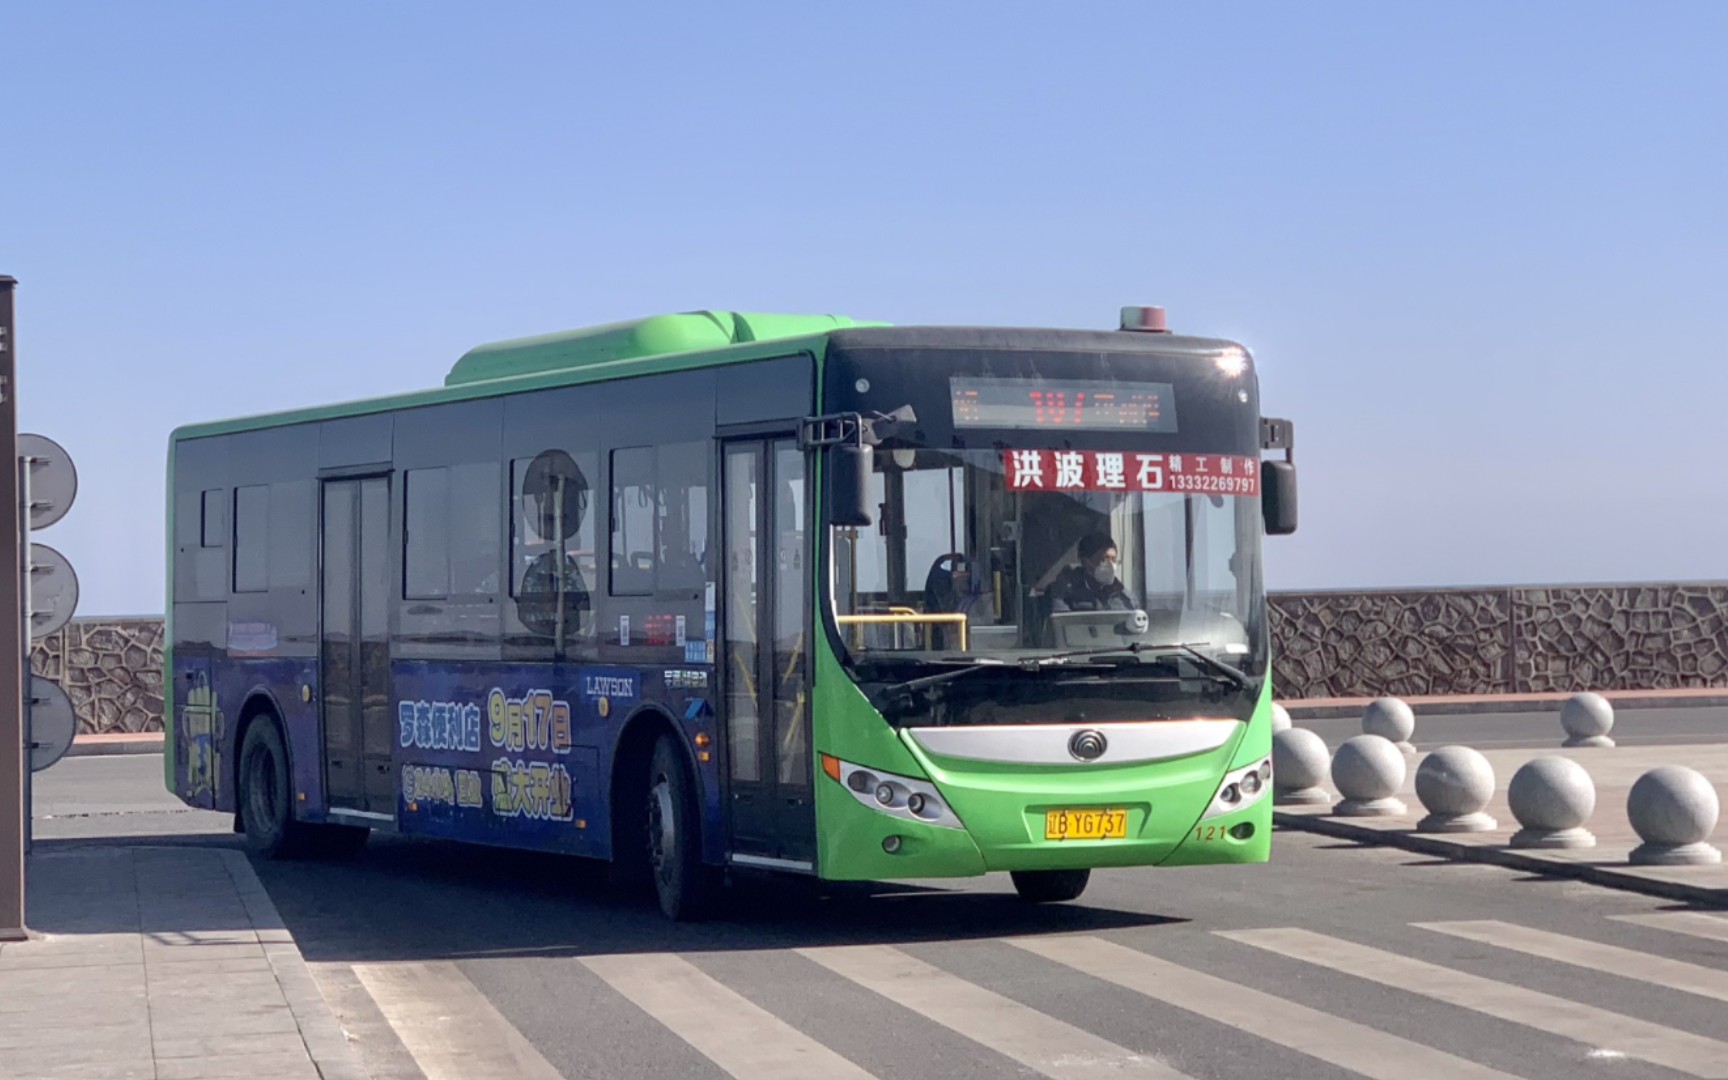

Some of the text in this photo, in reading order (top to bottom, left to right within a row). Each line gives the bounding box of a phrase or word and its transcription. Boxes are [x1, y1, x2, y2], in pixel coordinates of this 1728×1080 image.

[1012, 450, 1163, 488] 洪波理石
[1168, 454, 1255, 476] 精工制作
[1169, 475, 1255, 493] 13332269797
[586, 676, 634, 698] LAWSON
[398, 699, 481, 752] 罗森便利店
[487, 687, 572, 754] 9月17日
[1196, 825, 1227, 841] 121
